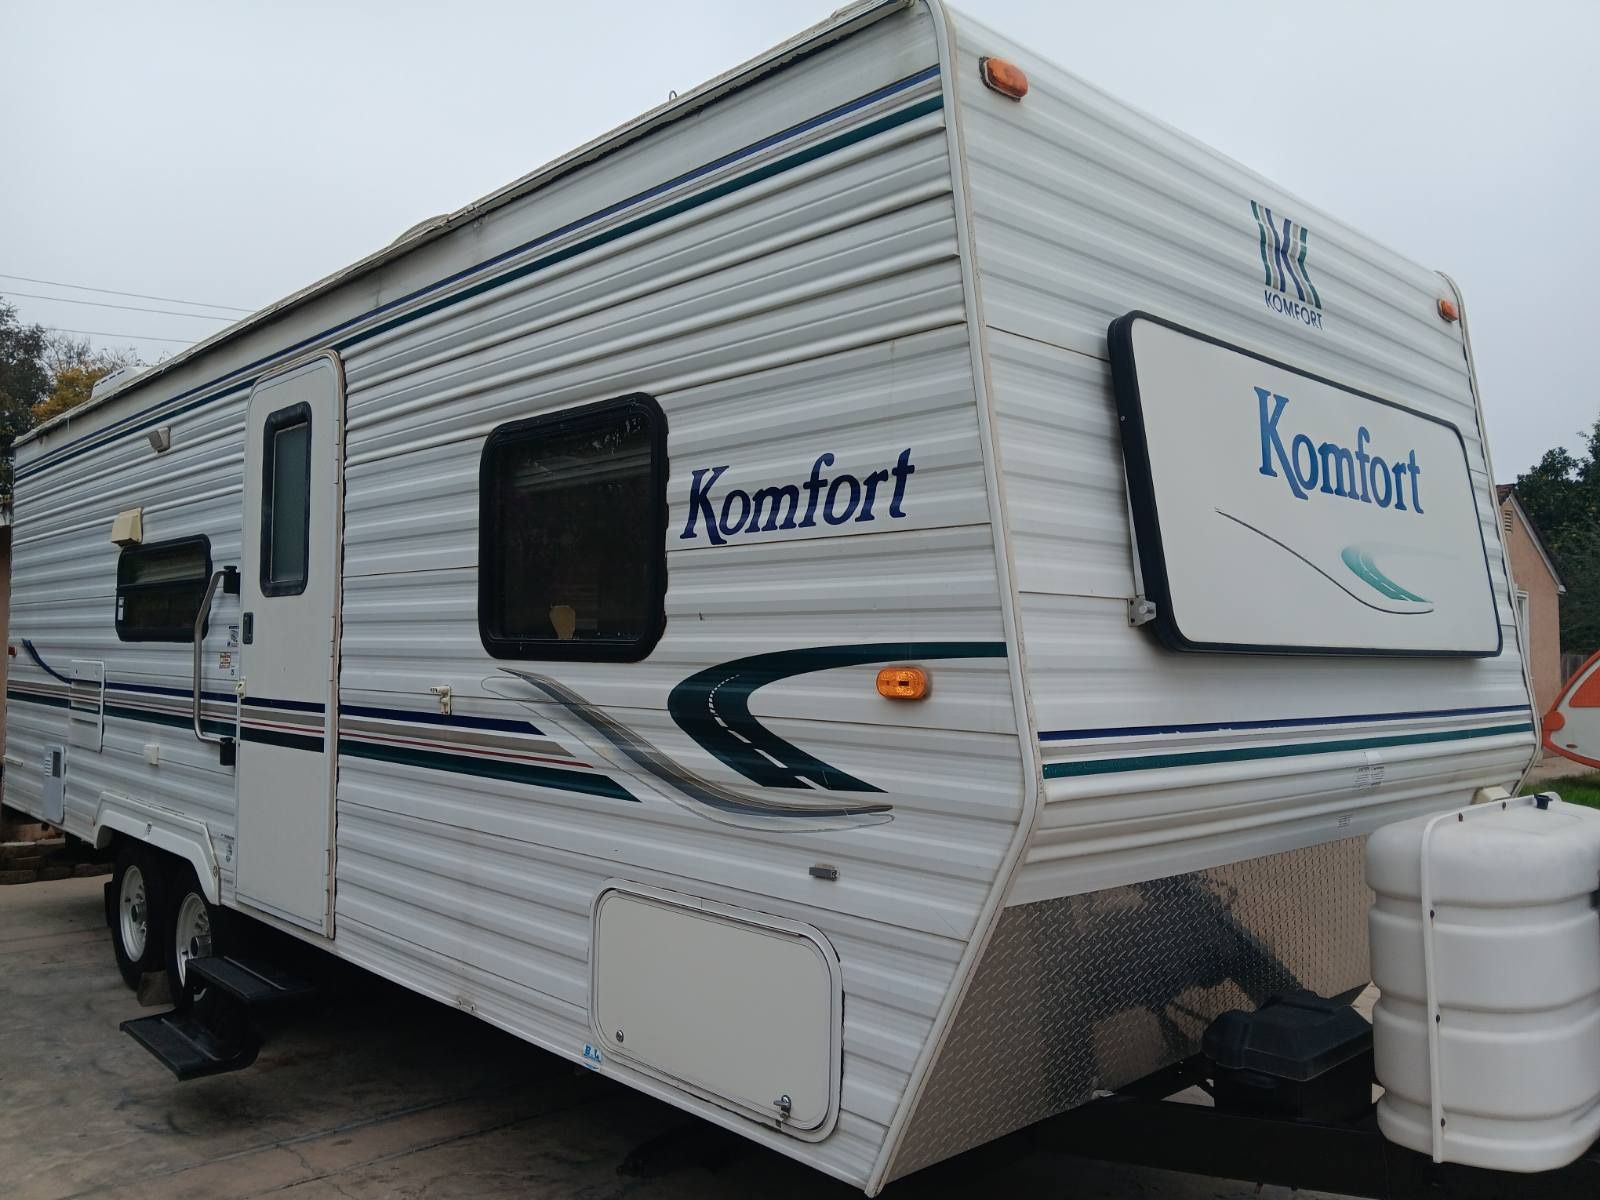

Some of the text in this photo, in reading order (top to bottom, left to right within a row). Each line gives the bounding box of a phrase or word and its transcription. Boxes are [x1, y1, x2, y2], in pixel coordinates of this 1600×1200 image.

[1264, 290, 1323, 330] KOMFORT
[680, 448, 915, 545] Komfort
[1254, 386, 1424, 514] Komfort
